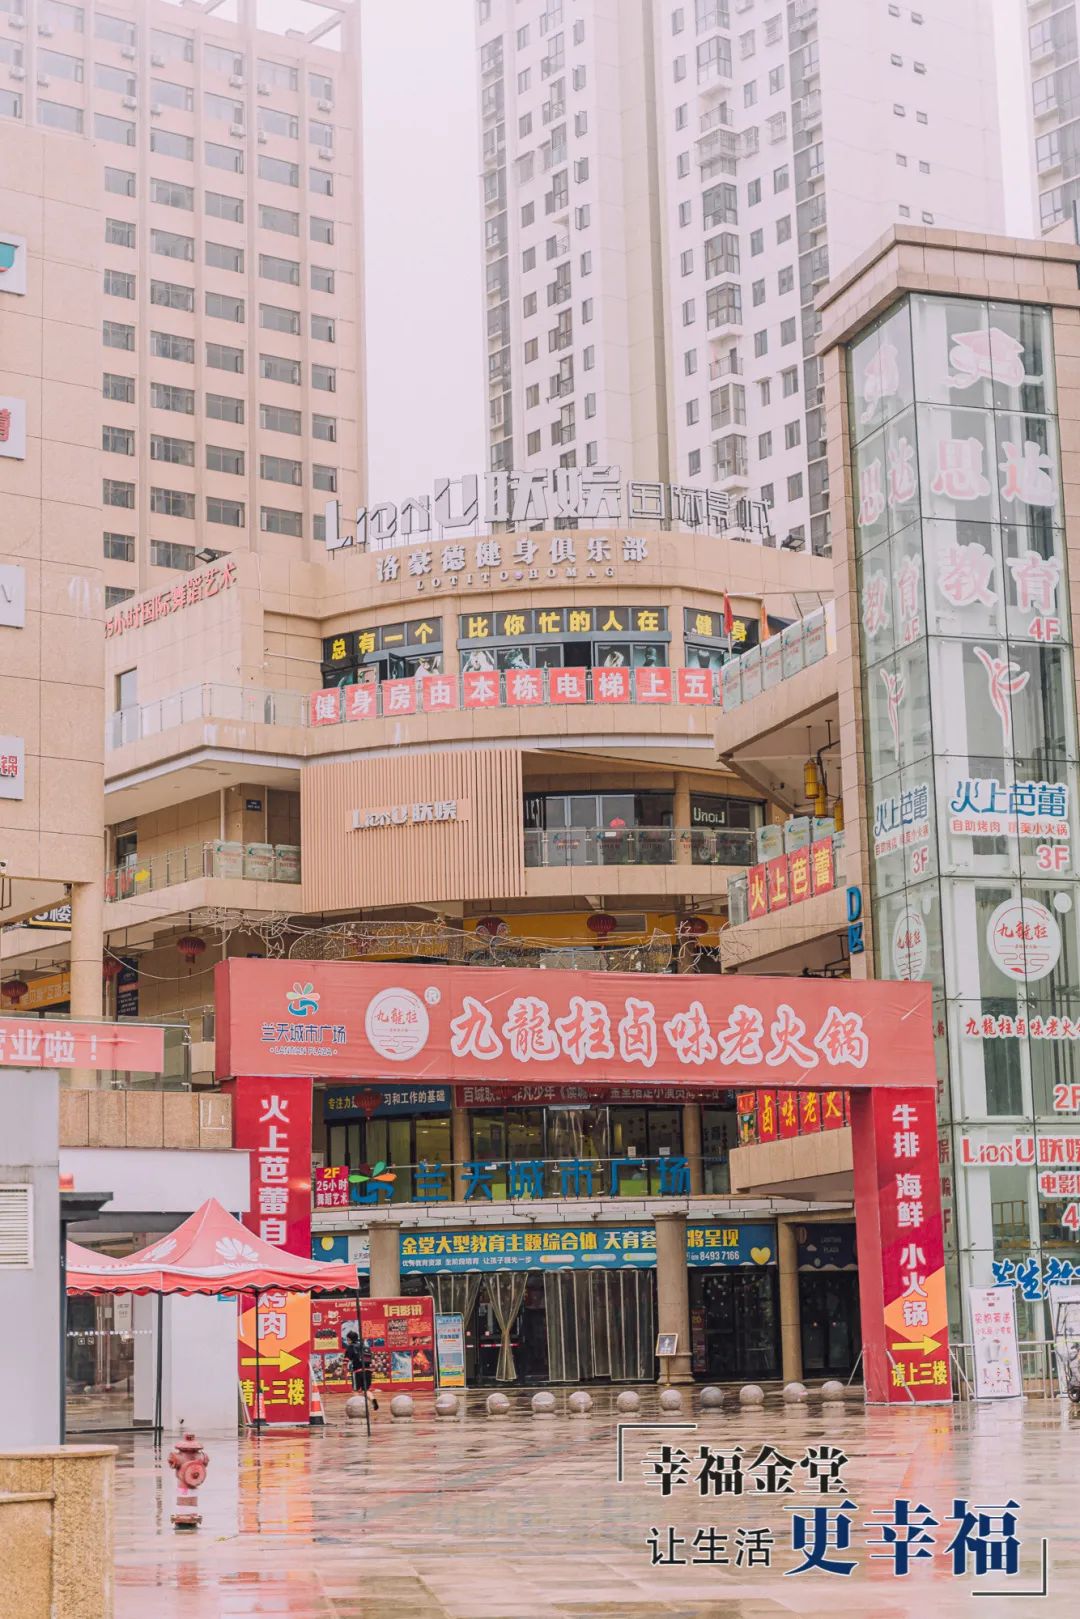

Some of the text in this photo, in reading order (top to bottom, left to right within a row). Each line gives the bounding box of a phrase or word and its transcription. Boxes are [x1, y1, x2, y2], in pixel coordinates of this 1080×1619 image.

[376, 536, 649, 581] 洛豪德健身俱乐部
[939, 543, 1060, 615] 教育
[332, 610, 747, 661] 总有一个 比你忙的人在 健身
[903, 619, 919, 645] 4F
[1029, 617, 1060, 642] 4F
[315, 668, 709, 720] 健身房由本栋电梯上五
[875, 785, 928, 837] 火上芭蕾
[951, 781, 1066, 817] 火上芭蕾
[913, 847, 928, 874] 3F
[1037, 846, 1069, 871] 3F
[750, 848, 832, 912] 火上芭蕾
[261, 1022, 347, 1044] 兰天城市广场
[965, 1017, 1080, 1037] 九龍柱卤味老火
[762, 1088, 850, 1135] 卤味老火
[962, 1138, 1035, 1163] LionU
[316, 1179, 348, 1192] 25小时
[324, 1167, 340, 1179] 2F
[412, 1155, 690, 1202] 兰天城市广场
[1041, 1174, 1080, 1194] 电影
[892, 1104, 928, 1327] 牛排 海鲜 小火锅
[402, 1231, 598, 1255] 金堂大型教育主题综合体
[892, 1360, 948, 1386] 请上三楼
